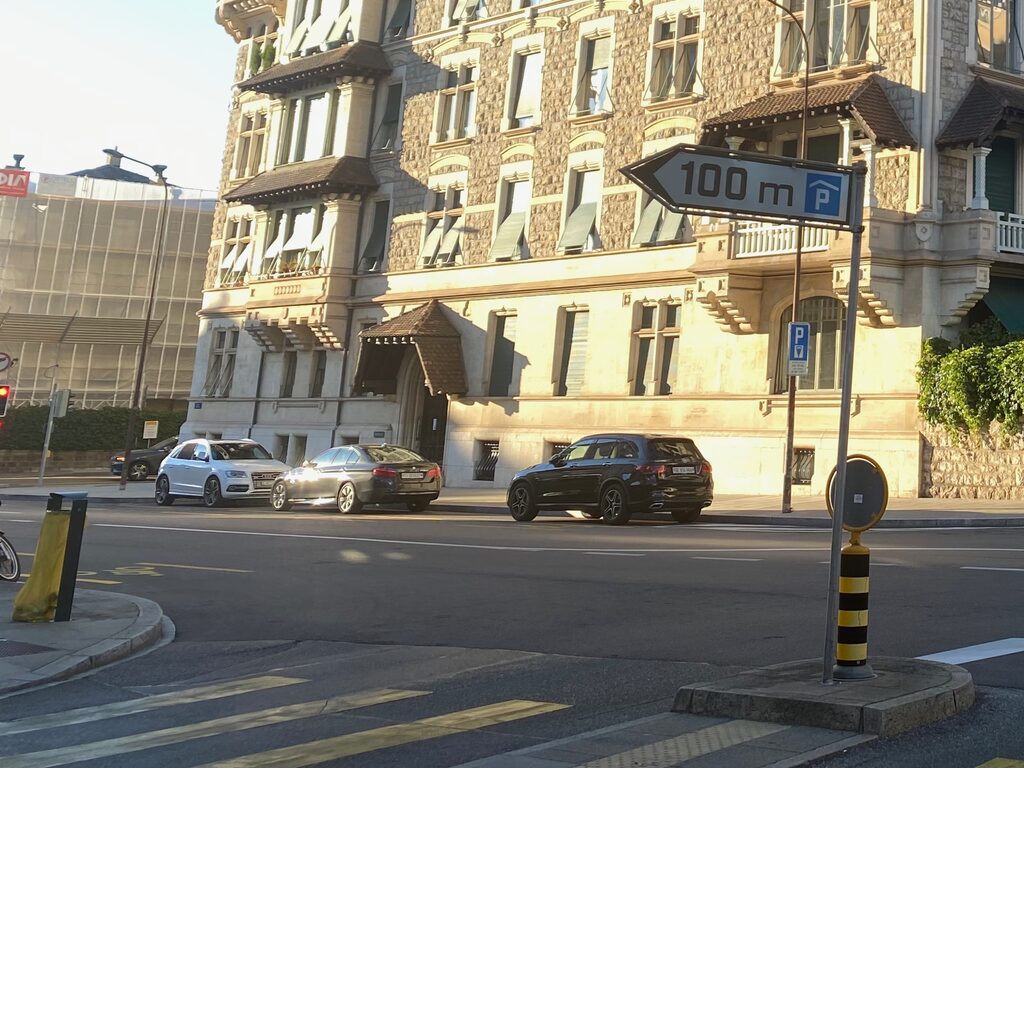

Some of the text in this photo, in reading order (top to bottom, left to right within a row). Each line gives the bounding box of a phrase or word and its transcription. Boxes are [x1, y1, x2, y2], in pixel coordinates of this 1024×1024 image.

[680, 160, 830, 210] 100 m P
[795, 326, 805, 345] P
